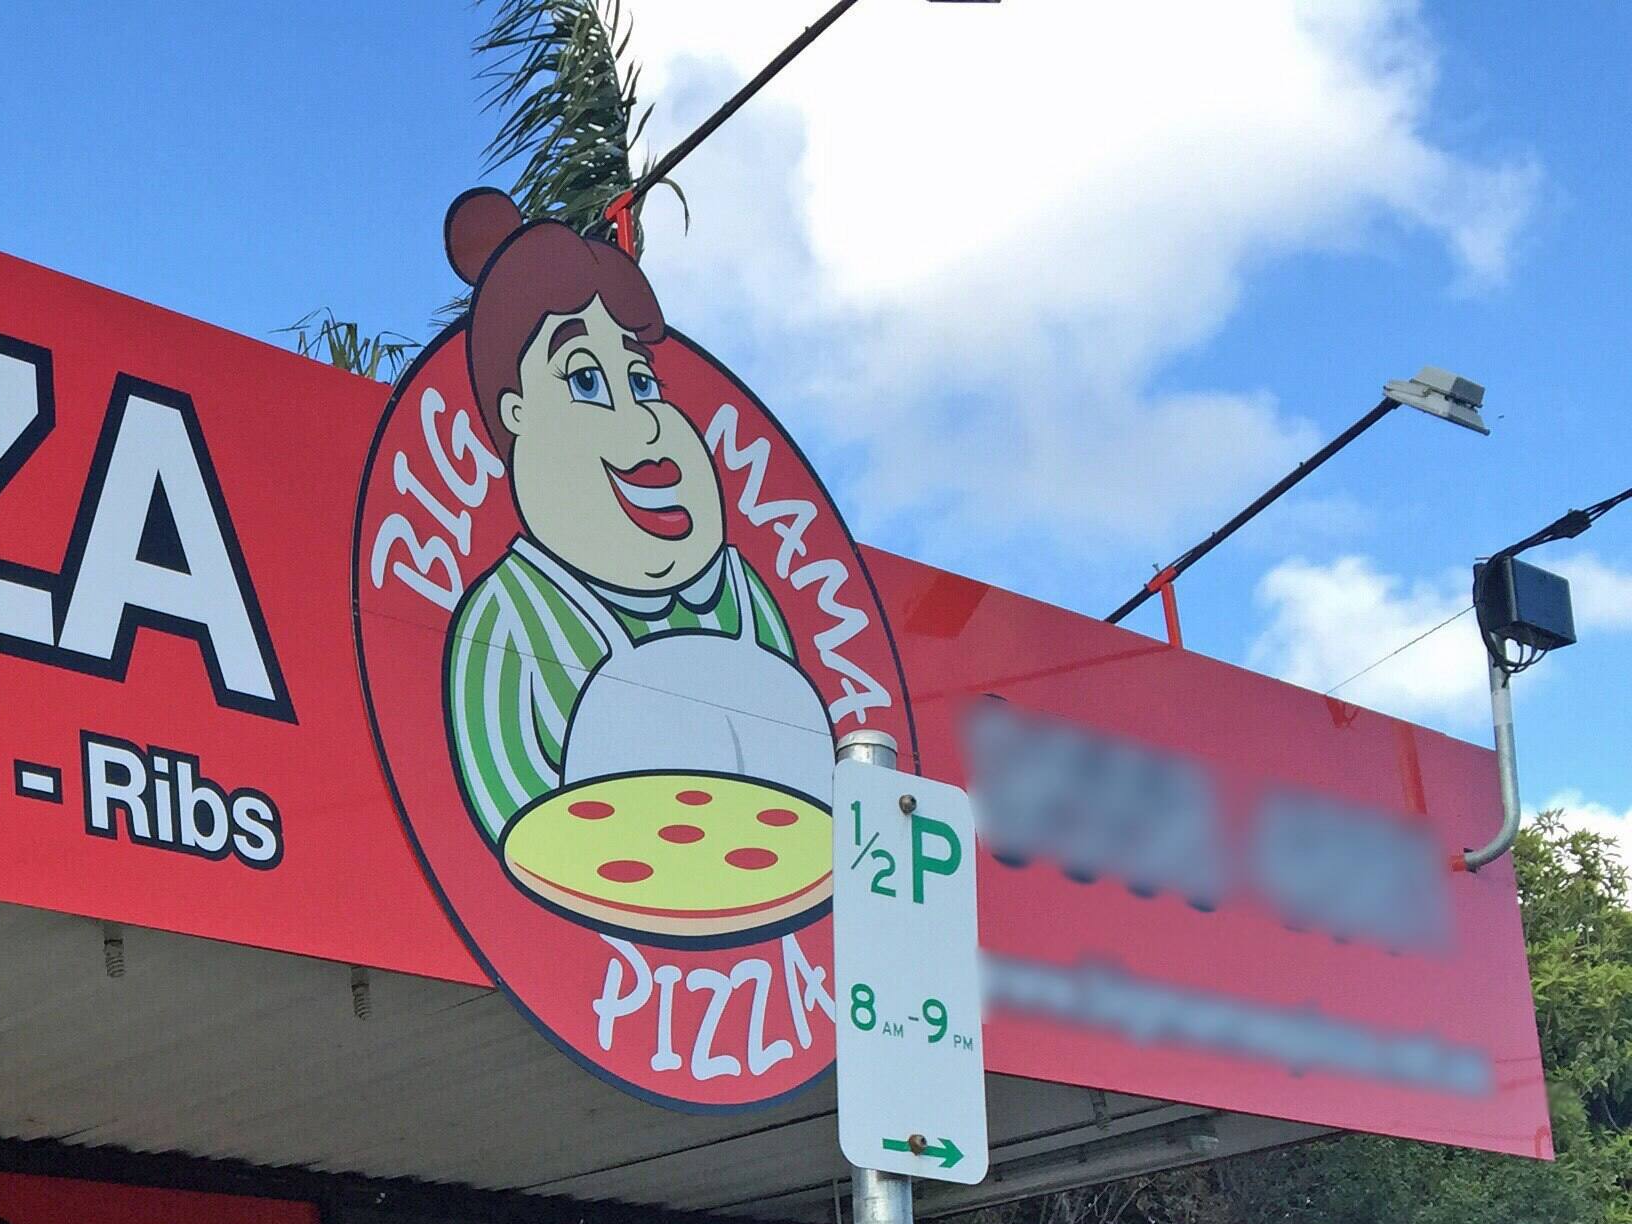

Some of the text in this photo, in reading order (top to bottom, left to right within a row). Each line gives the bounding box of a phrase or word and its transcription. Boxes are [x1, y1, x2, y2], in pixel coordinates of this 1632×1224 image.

[372, 388, 504, 611] BIG
[81, 731, 282, 870] Ribs
[595, 933, 835, 1081] PIZZA
